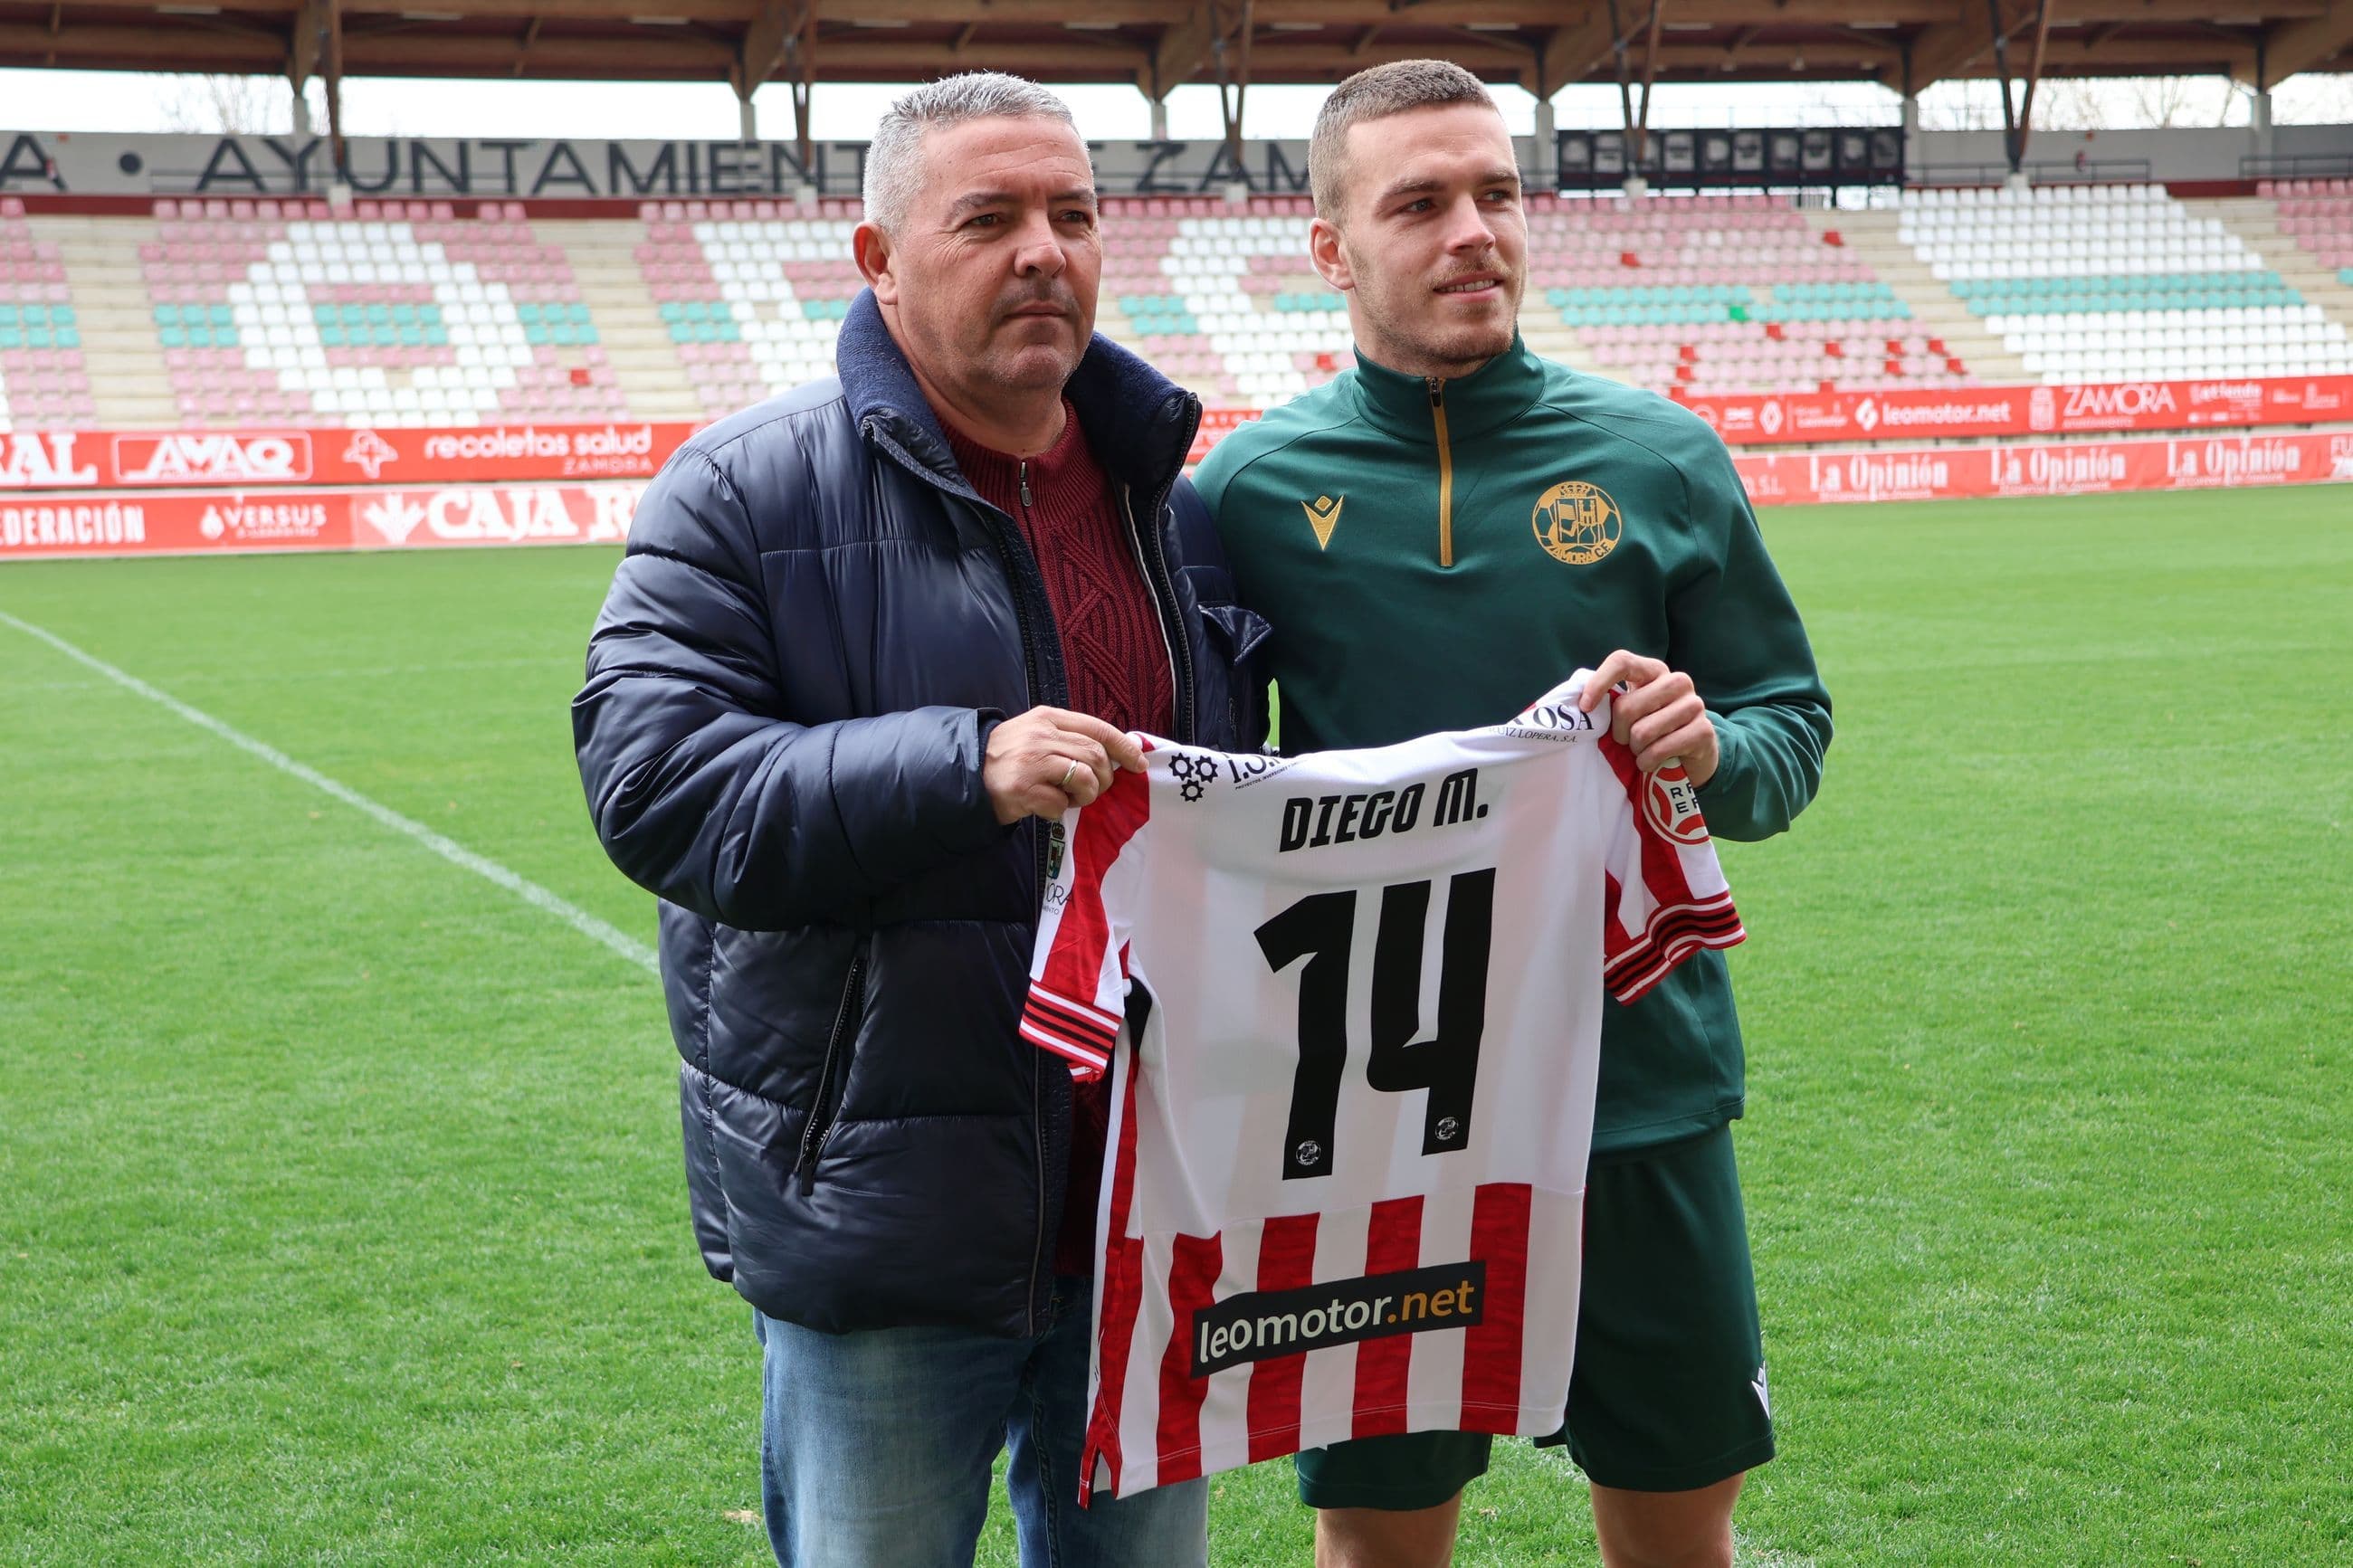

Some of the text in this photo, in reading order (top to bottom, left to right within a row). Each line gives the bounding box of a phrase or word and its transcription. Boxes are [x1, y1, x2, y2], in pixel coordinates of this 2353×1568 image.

[1881, 402, 2012, 426] leomotor.net
[2062, 383, 2177, 416] ZAMORA
[424, 424, 653, 459] recoletos salud
[563, 456, 654, 476] ZAMORA
[2167, 441, 2198, 478] La
[2205, 436, 2301, 487] Opinión
[1810, 451, 1948, 501] La Opinión
[1990, 445, 2127, 494] La Opinión
[223, 504, 328, 529] VERSUS
[427, 489, 580, 541] CAJA
[1279, 767, 1489, 852] DIEGO M.
[1253, 867, 1498, 1182] 14
[1199, 1279, 1476, 1364] leomotor.net
